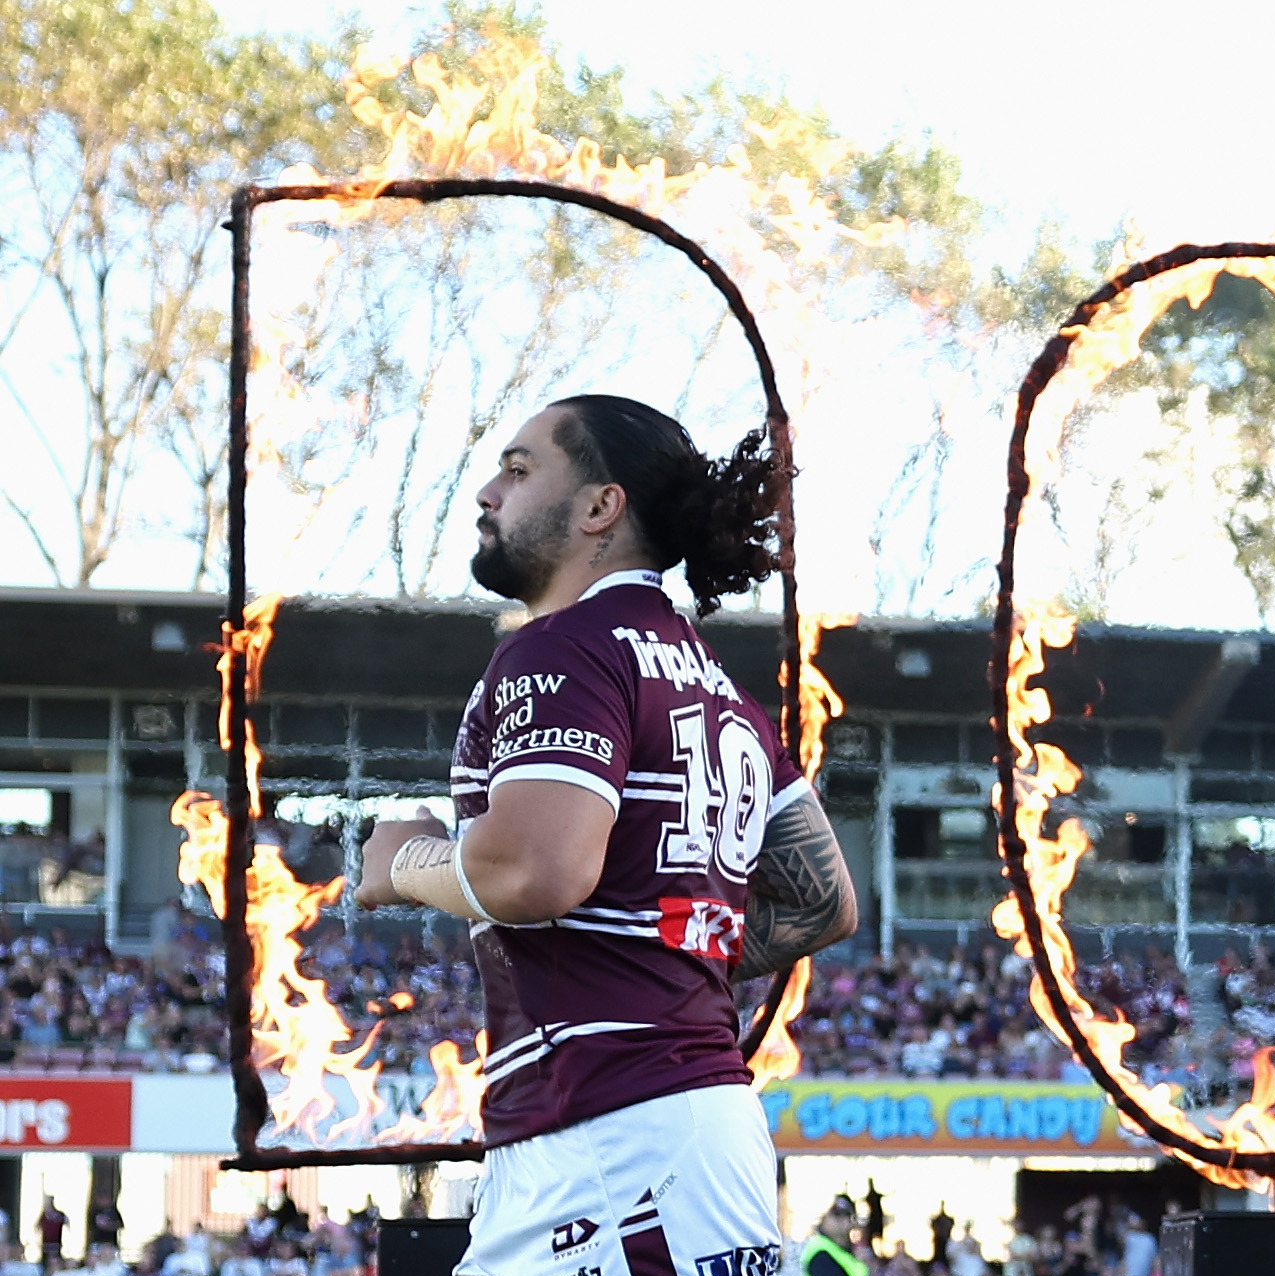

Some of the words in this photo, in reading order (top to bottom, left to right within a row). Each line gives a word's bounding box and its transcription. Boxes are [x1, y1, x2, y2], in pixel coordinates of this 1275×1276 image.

[495, 673, 566, 716] Shaw
[656, 702, 774, 885] 10
[796, 1093, 938, 1140] SOUR
[946, 1095, 1104, 1146] CANDY
